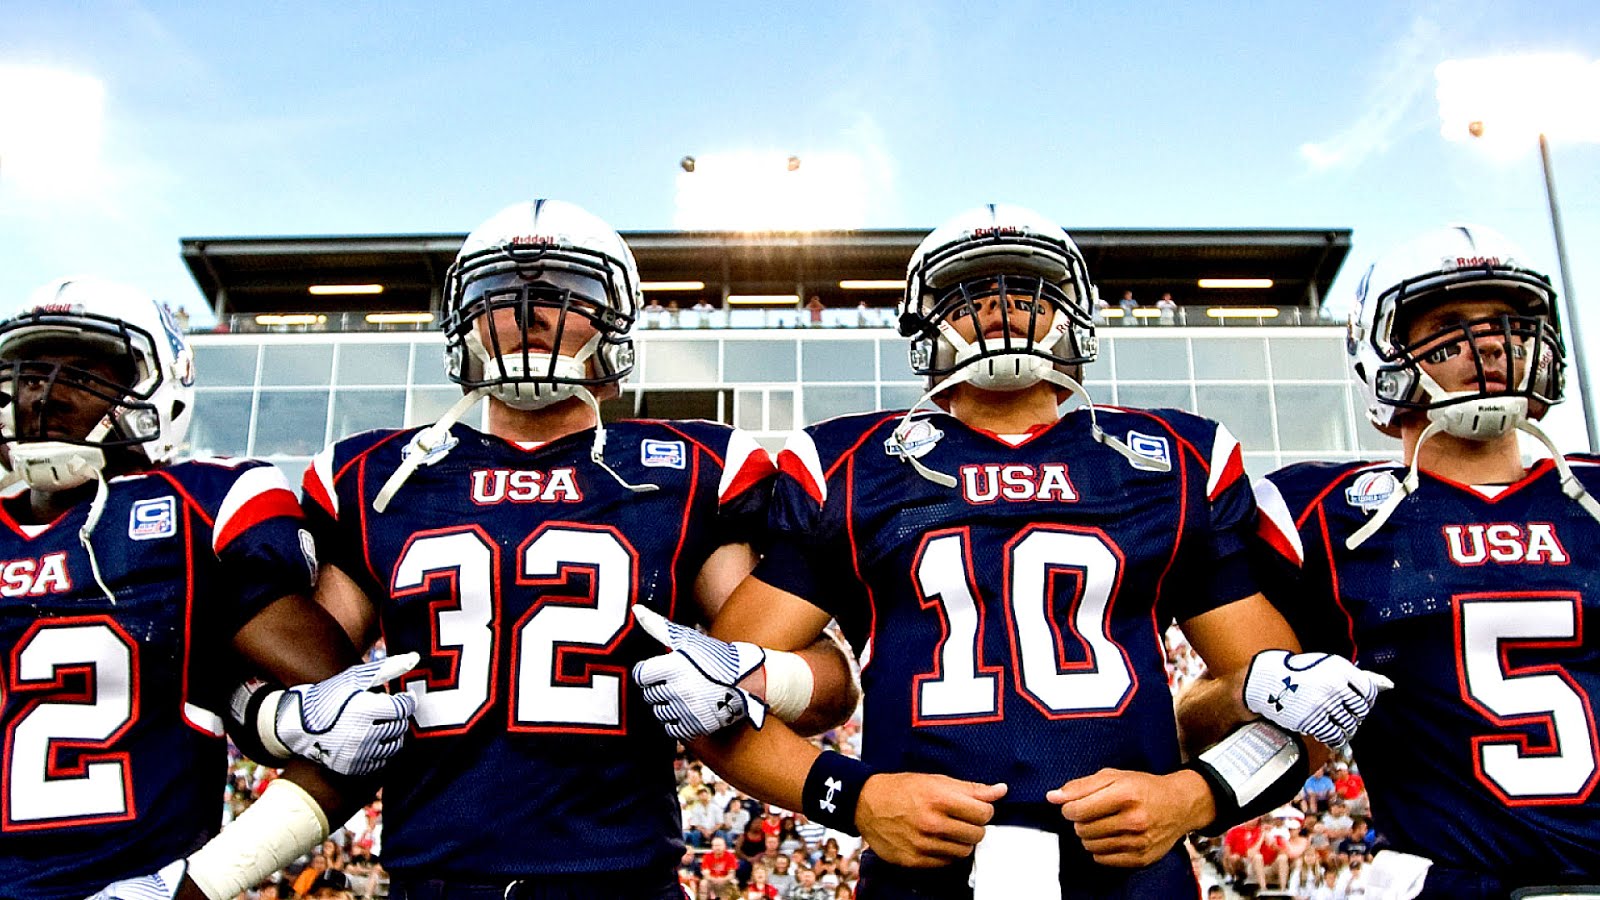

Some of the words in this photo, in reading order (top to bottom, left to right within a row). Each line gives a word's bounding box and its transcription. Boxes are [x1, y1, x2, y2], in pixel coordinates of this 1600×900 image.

[470, 467, 584, 506] USA
[960, 462, 1079, 505] USA
[1443, 521, 1571, 567] USA
[0, 551, 72, 598] SA
[390, 520, 639, 738] 32
[910, 522, 1139, 727] 10
[0, 614, 140, 832] 2
[1452, 591, 1600, 807] 5
